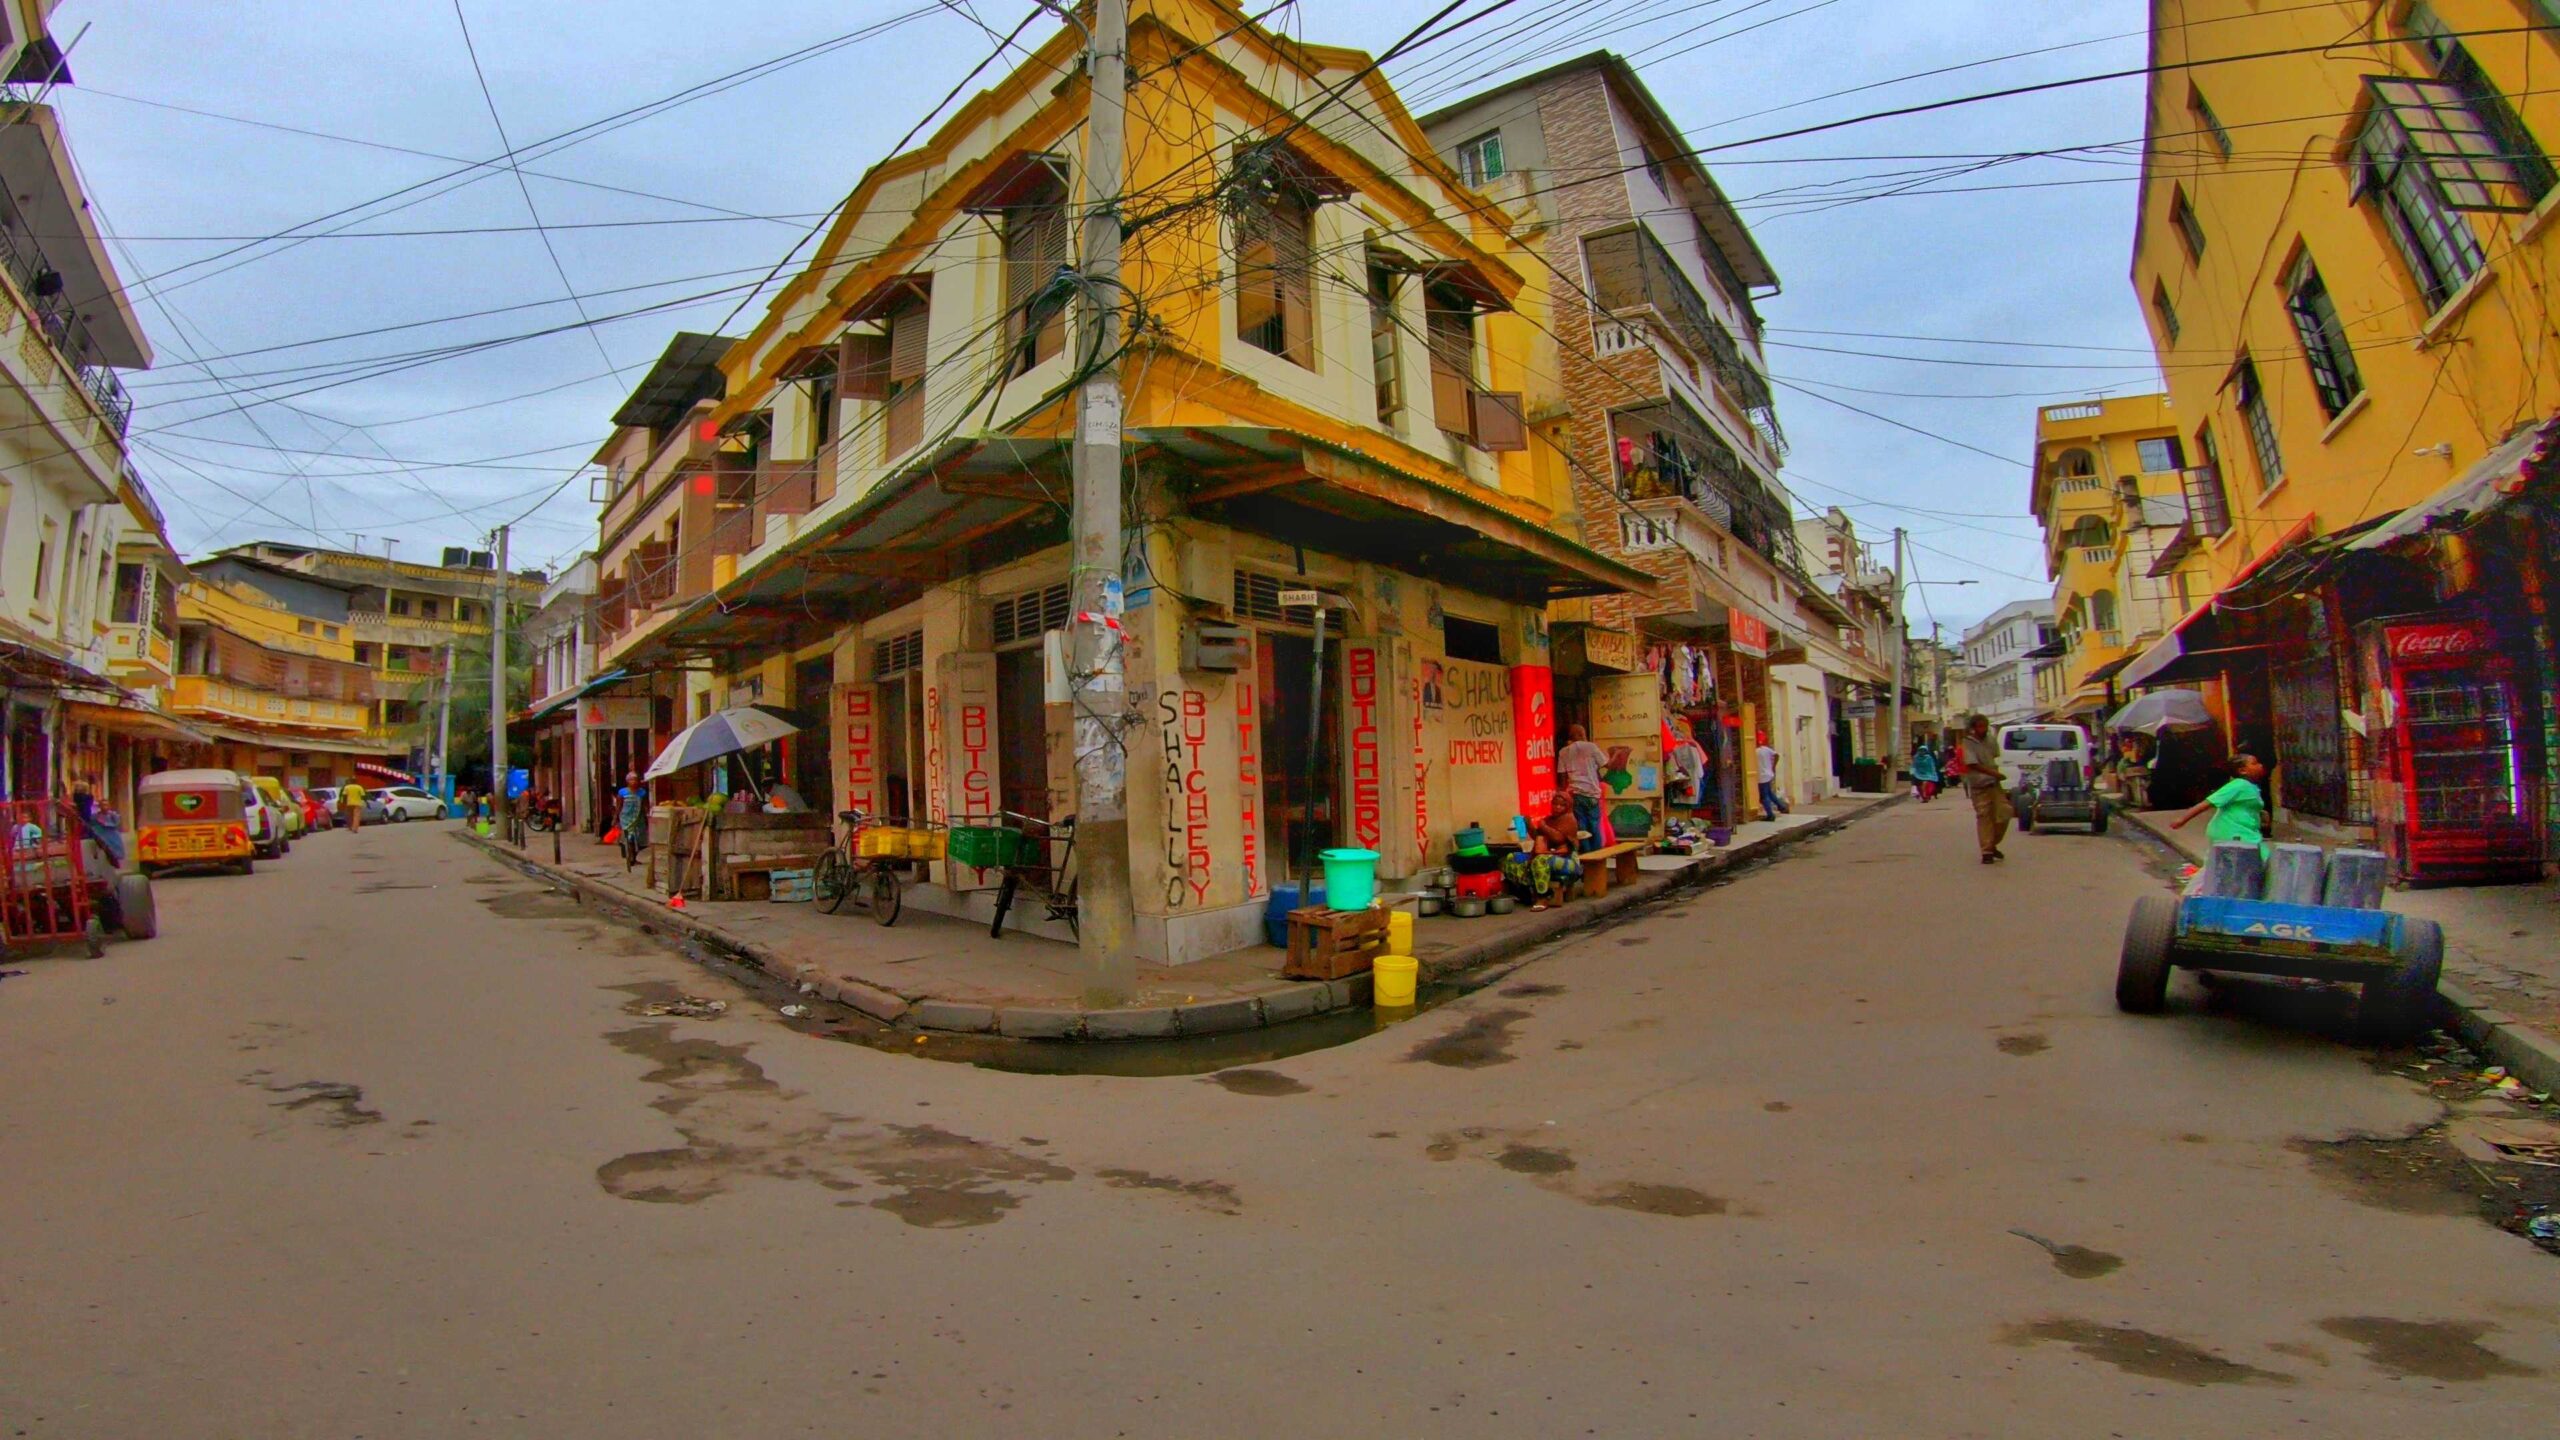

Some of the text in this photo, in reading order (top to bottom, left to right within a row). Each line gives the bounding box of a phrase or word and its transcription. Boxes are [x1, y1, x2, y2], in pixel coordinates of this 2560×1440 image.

[1282, 593, 1316, 602] SHARIF
[1464, 711, 1509, 738] TOSHA
[1349, 647, 1380, 850] BUTCHERY
[1448, 739, 1505, 766] UTCHERY
[1158, 690, 1185, 907] SHALLO
[1182, 689, 1211, 906] BUTCHERY
[2243, 922, 2314, 939] AGK
